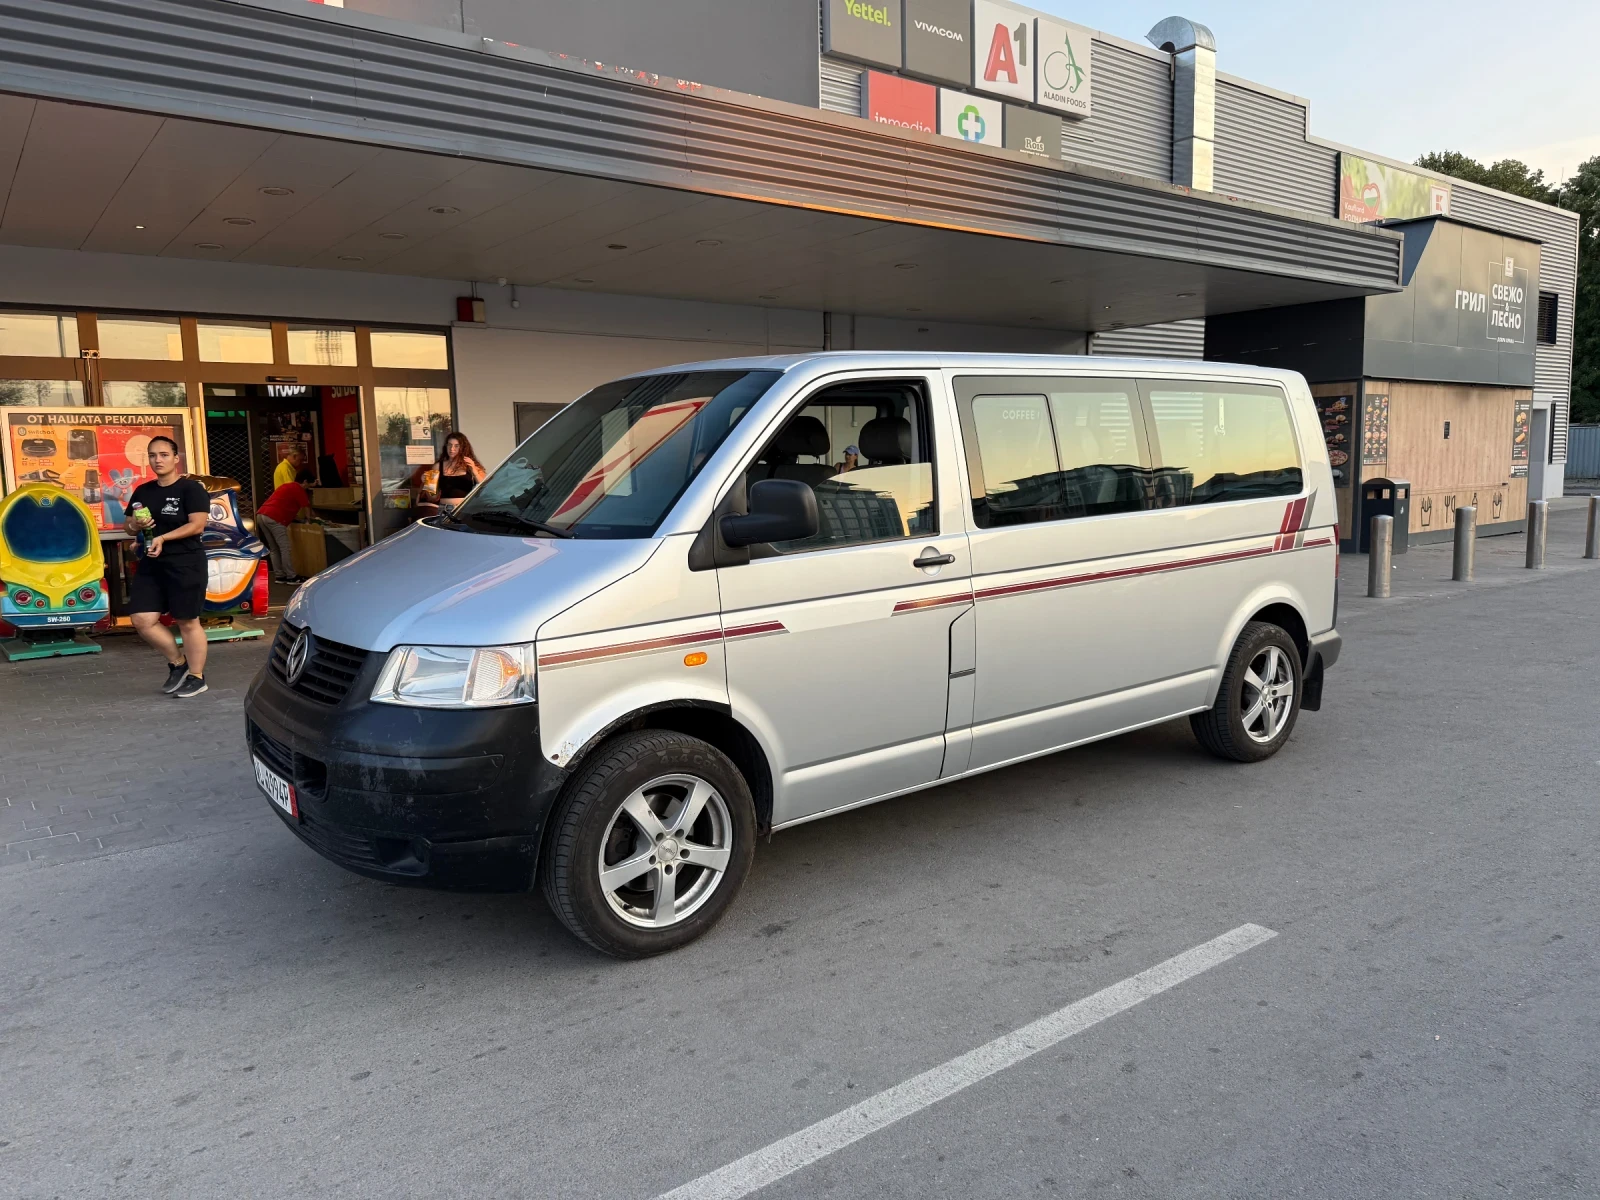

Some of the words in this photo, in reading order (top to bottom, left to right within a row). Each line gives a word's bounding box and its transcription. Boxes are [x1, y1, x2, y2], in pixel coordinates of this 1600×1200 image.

[914, 20, 963, 42] VIVACOM
[984, 22, 1027, 84] A1
[1043, 91, 1066, 104] ALADIN
[1066, 98, 1087, 109] FOODS
[1454, 289, 1486, 313] ГРИЛ
[1492, 283, 1524, 304] СВЕЖО
[1491, 309, 1522, 330] ЛЕСНО
[26, 414, 45, 424] ОТ
[47, 414, 102, 424] НАШАТА
[1002, 409, 1035, 420] COFFEE
